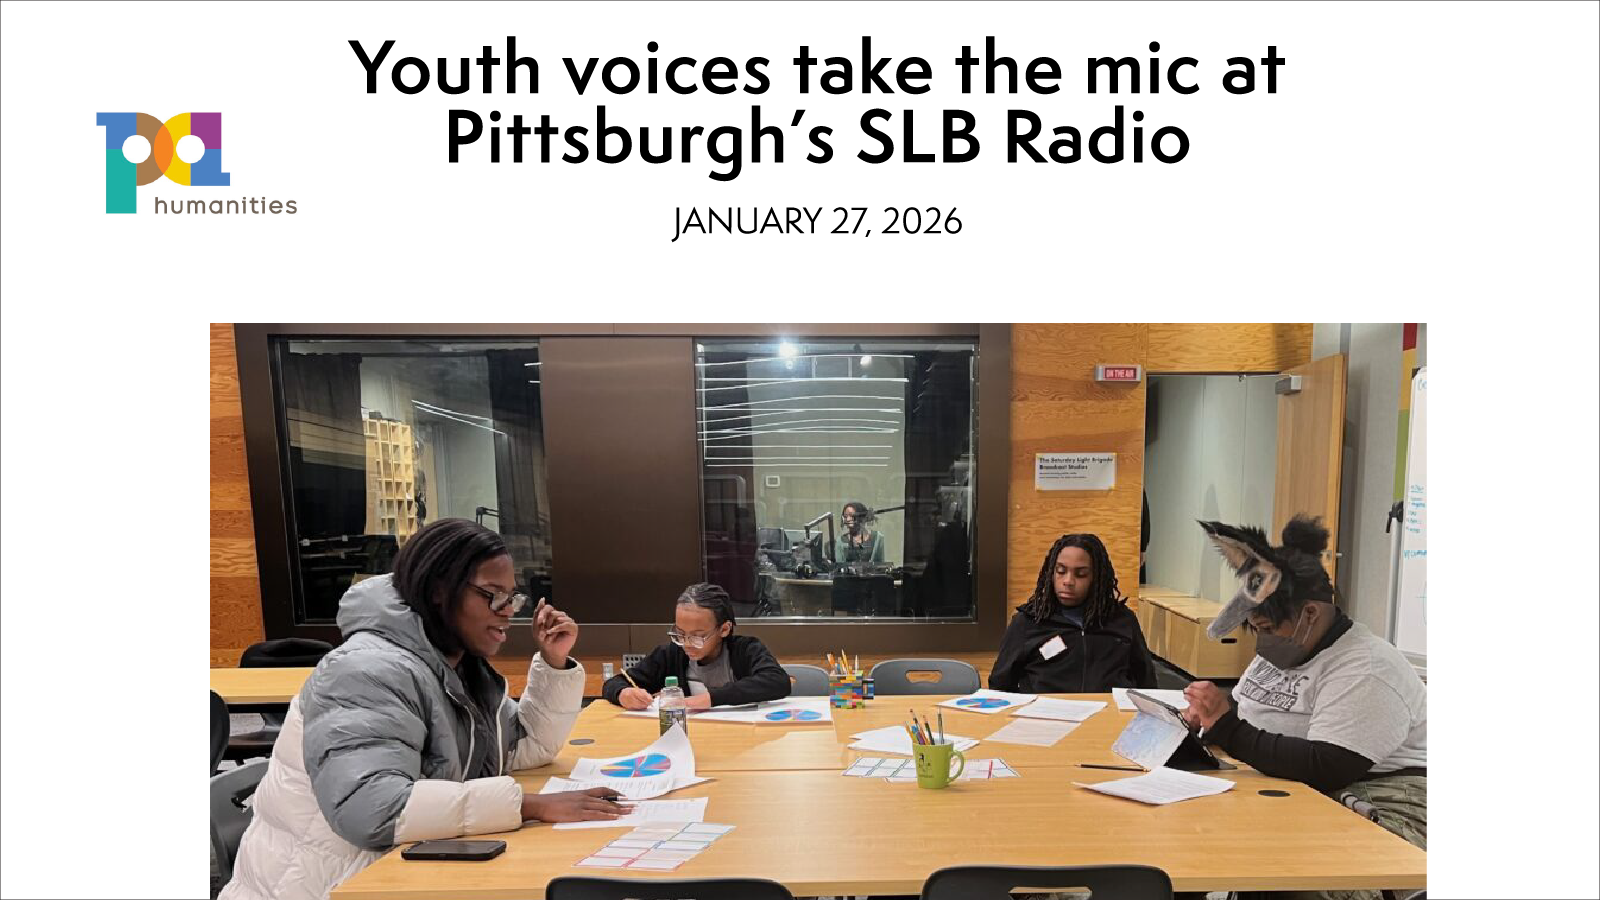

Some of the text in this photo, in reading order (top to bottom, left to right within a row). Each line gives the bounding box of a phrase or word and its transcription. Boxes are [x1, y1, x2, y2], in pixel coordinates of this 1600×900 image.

[1106, 369, 1134, 378] ON THE AIR
